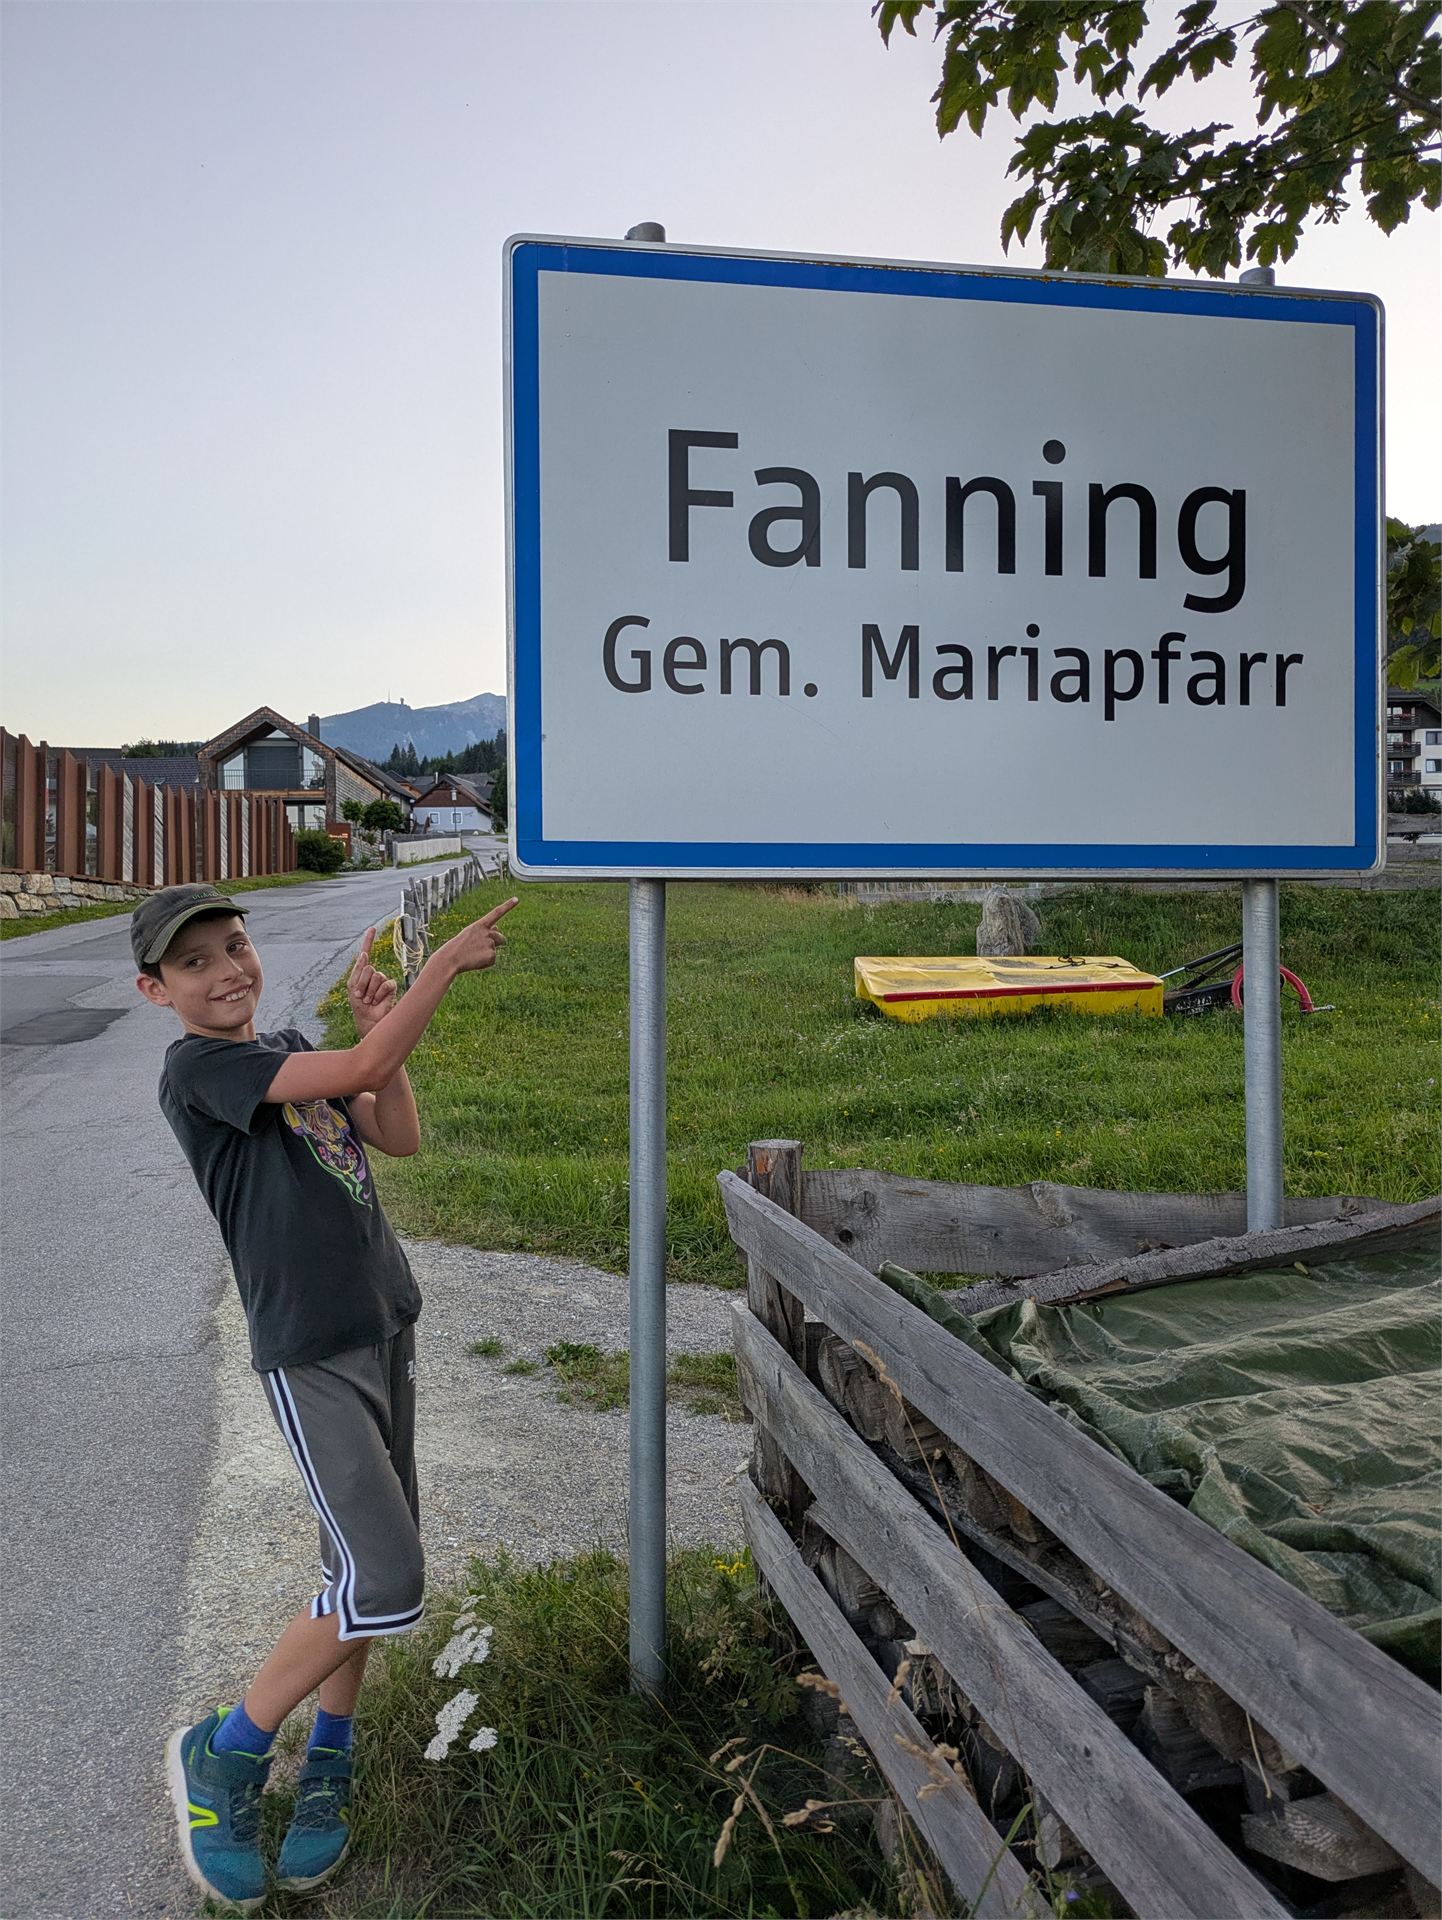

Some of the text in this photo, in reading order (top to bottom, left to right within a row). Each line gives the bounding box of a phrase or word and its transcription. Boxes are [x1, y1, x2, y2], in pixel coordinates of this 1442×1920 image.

[668, 428, 1247, 614] Fanning
[602, 615, 1305, 722] Gem. Mariapfarr
